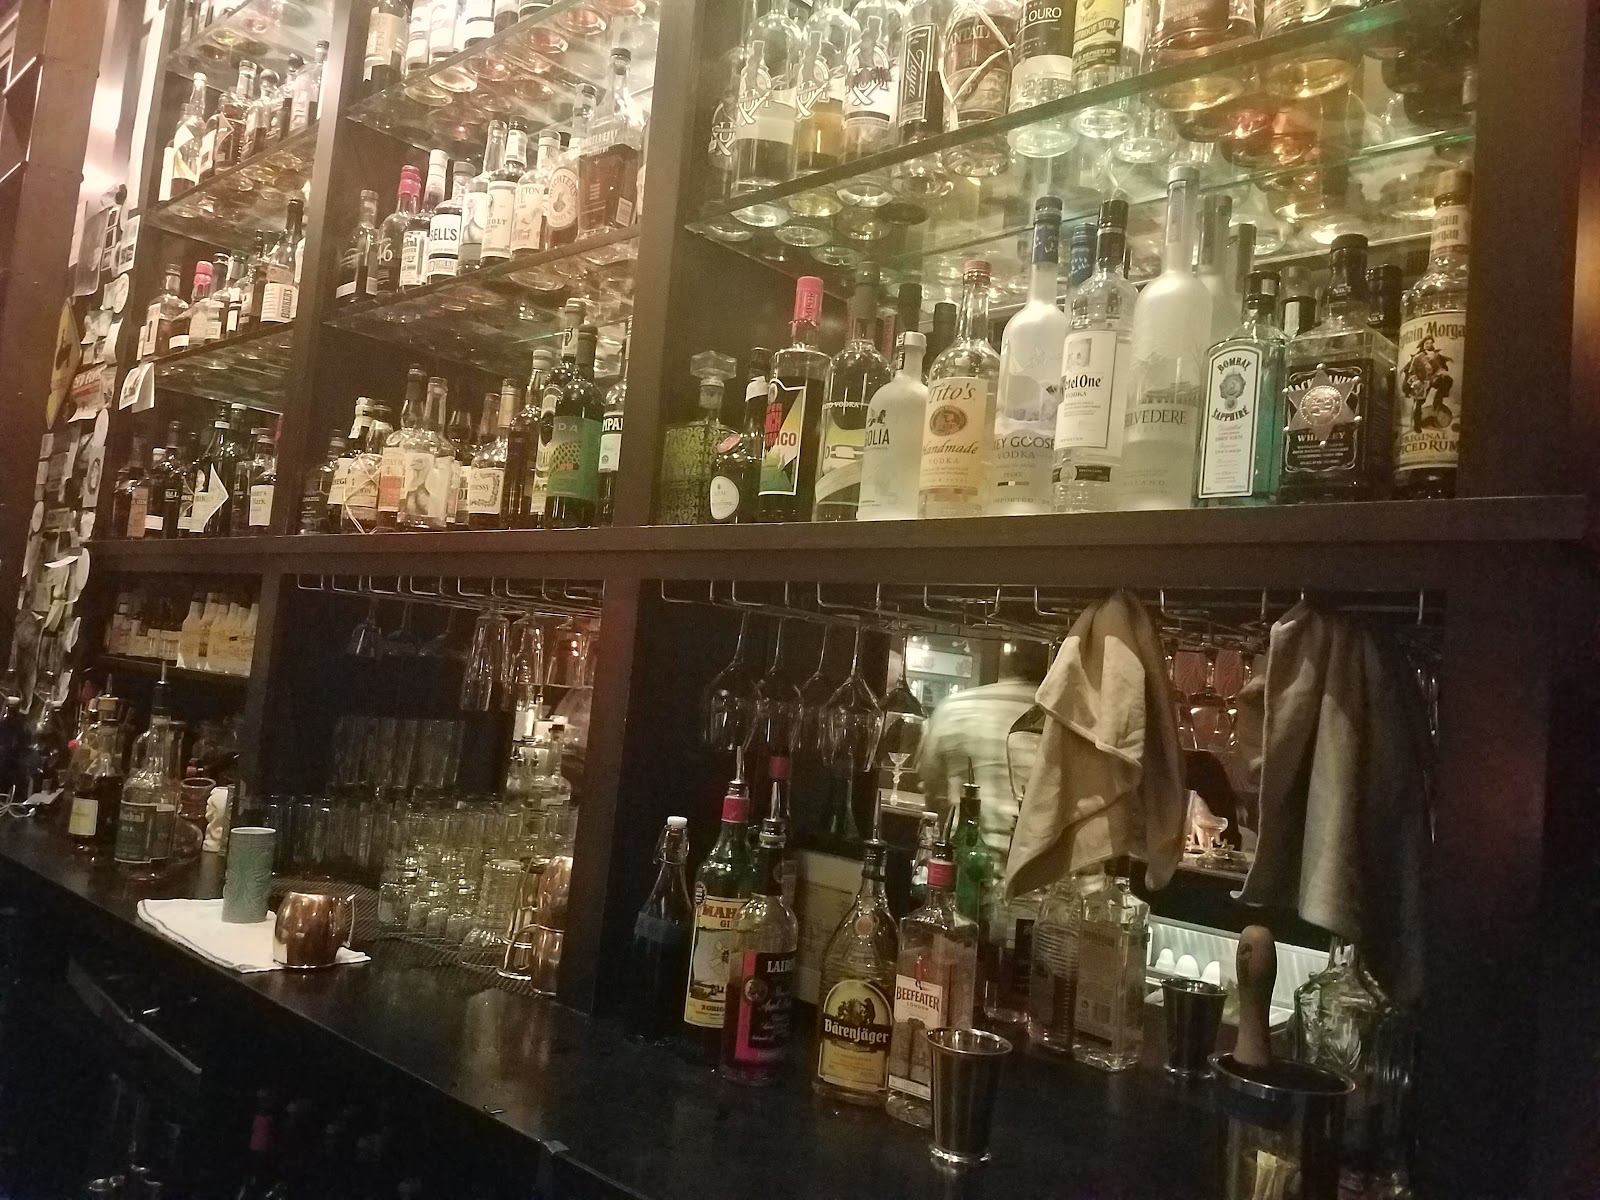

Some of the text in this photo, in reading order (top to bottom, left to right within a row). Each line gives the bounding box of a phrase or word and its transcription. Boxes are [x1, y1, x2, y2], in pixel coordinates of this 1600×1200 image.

[1029, 7, 1062, 22] OURO
[1098, 19, 1117, 33] RUM
[905, 48, 925, 99] Zaya
[1217, 357, 1252, 375] BOMBAY
[1080, 374, 1103, 389] One
[928, 382, 976, 404] Tito's
[1211, 405, 1250, 422] SAPPHIRE
[921, 440, 980, 457] Handmade
[1010, 435, 1055, 451] GOOSE
[997, 451, 1036, 460] VODKA
[896, 986, 940, 1012] BEEFEATER
[906, 1001, 930, 1011] LONDON
